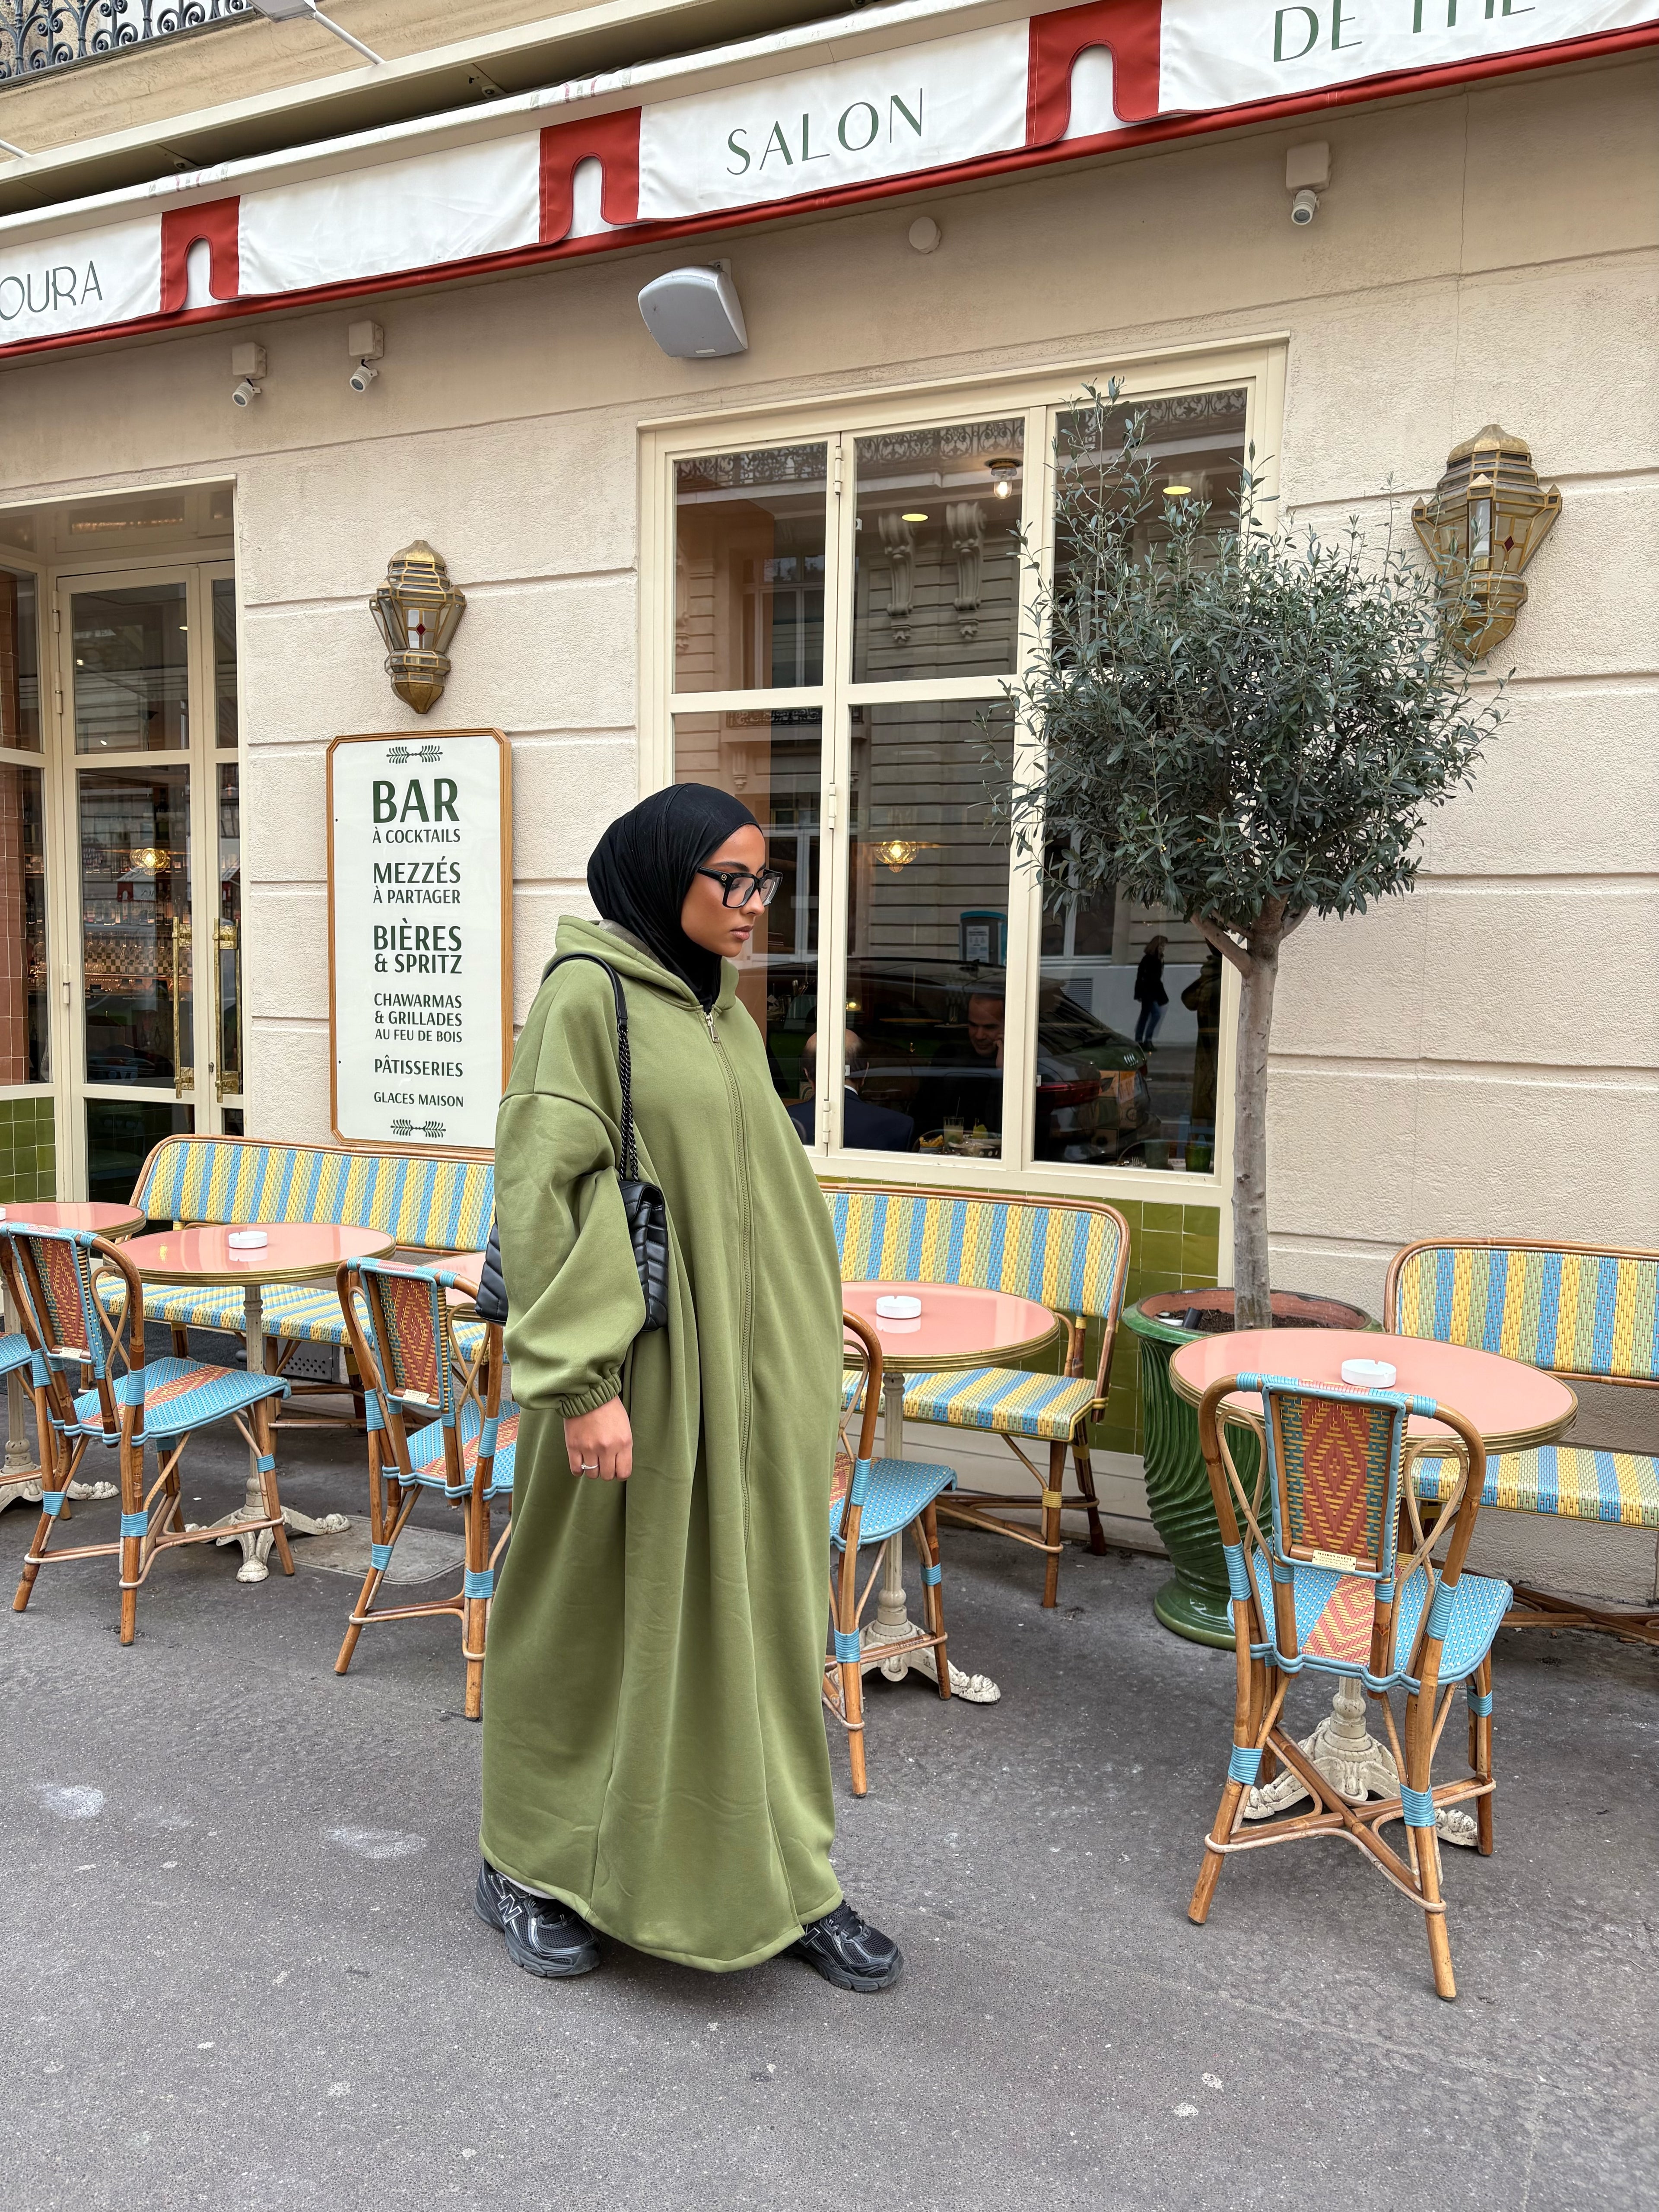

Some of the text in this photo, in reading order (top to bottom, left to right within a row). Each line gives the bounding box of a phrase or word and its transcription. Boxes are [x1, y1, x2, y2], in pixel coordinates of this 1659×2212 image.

[727, 88, 923, 175] SALON
[1274, 0, 1362, 62] DE
[0, 261, 102, 321] OURA
[373, 778, 460, 823] BAR
[372, 826, 461, 844] À COCKTAILS
[374, 856, 461, 884] MEZZÉS
[373, 886, 461, 904] À PARTAGER
[374, 918, 462, 951] BIÈRES
[374, 953, 462, 974] & SPRITZ
[374, 993, 462, 1008] CHAWARMAS
[375, 1011, 462, 1027] & GRILLADES
[375, 1029, 462, 1043] AU FEU DE BOIS
[375, 1055, 463, 1077] PÂTISSERIES
[374, 1091, 463, 1107] GLACES MAISON
